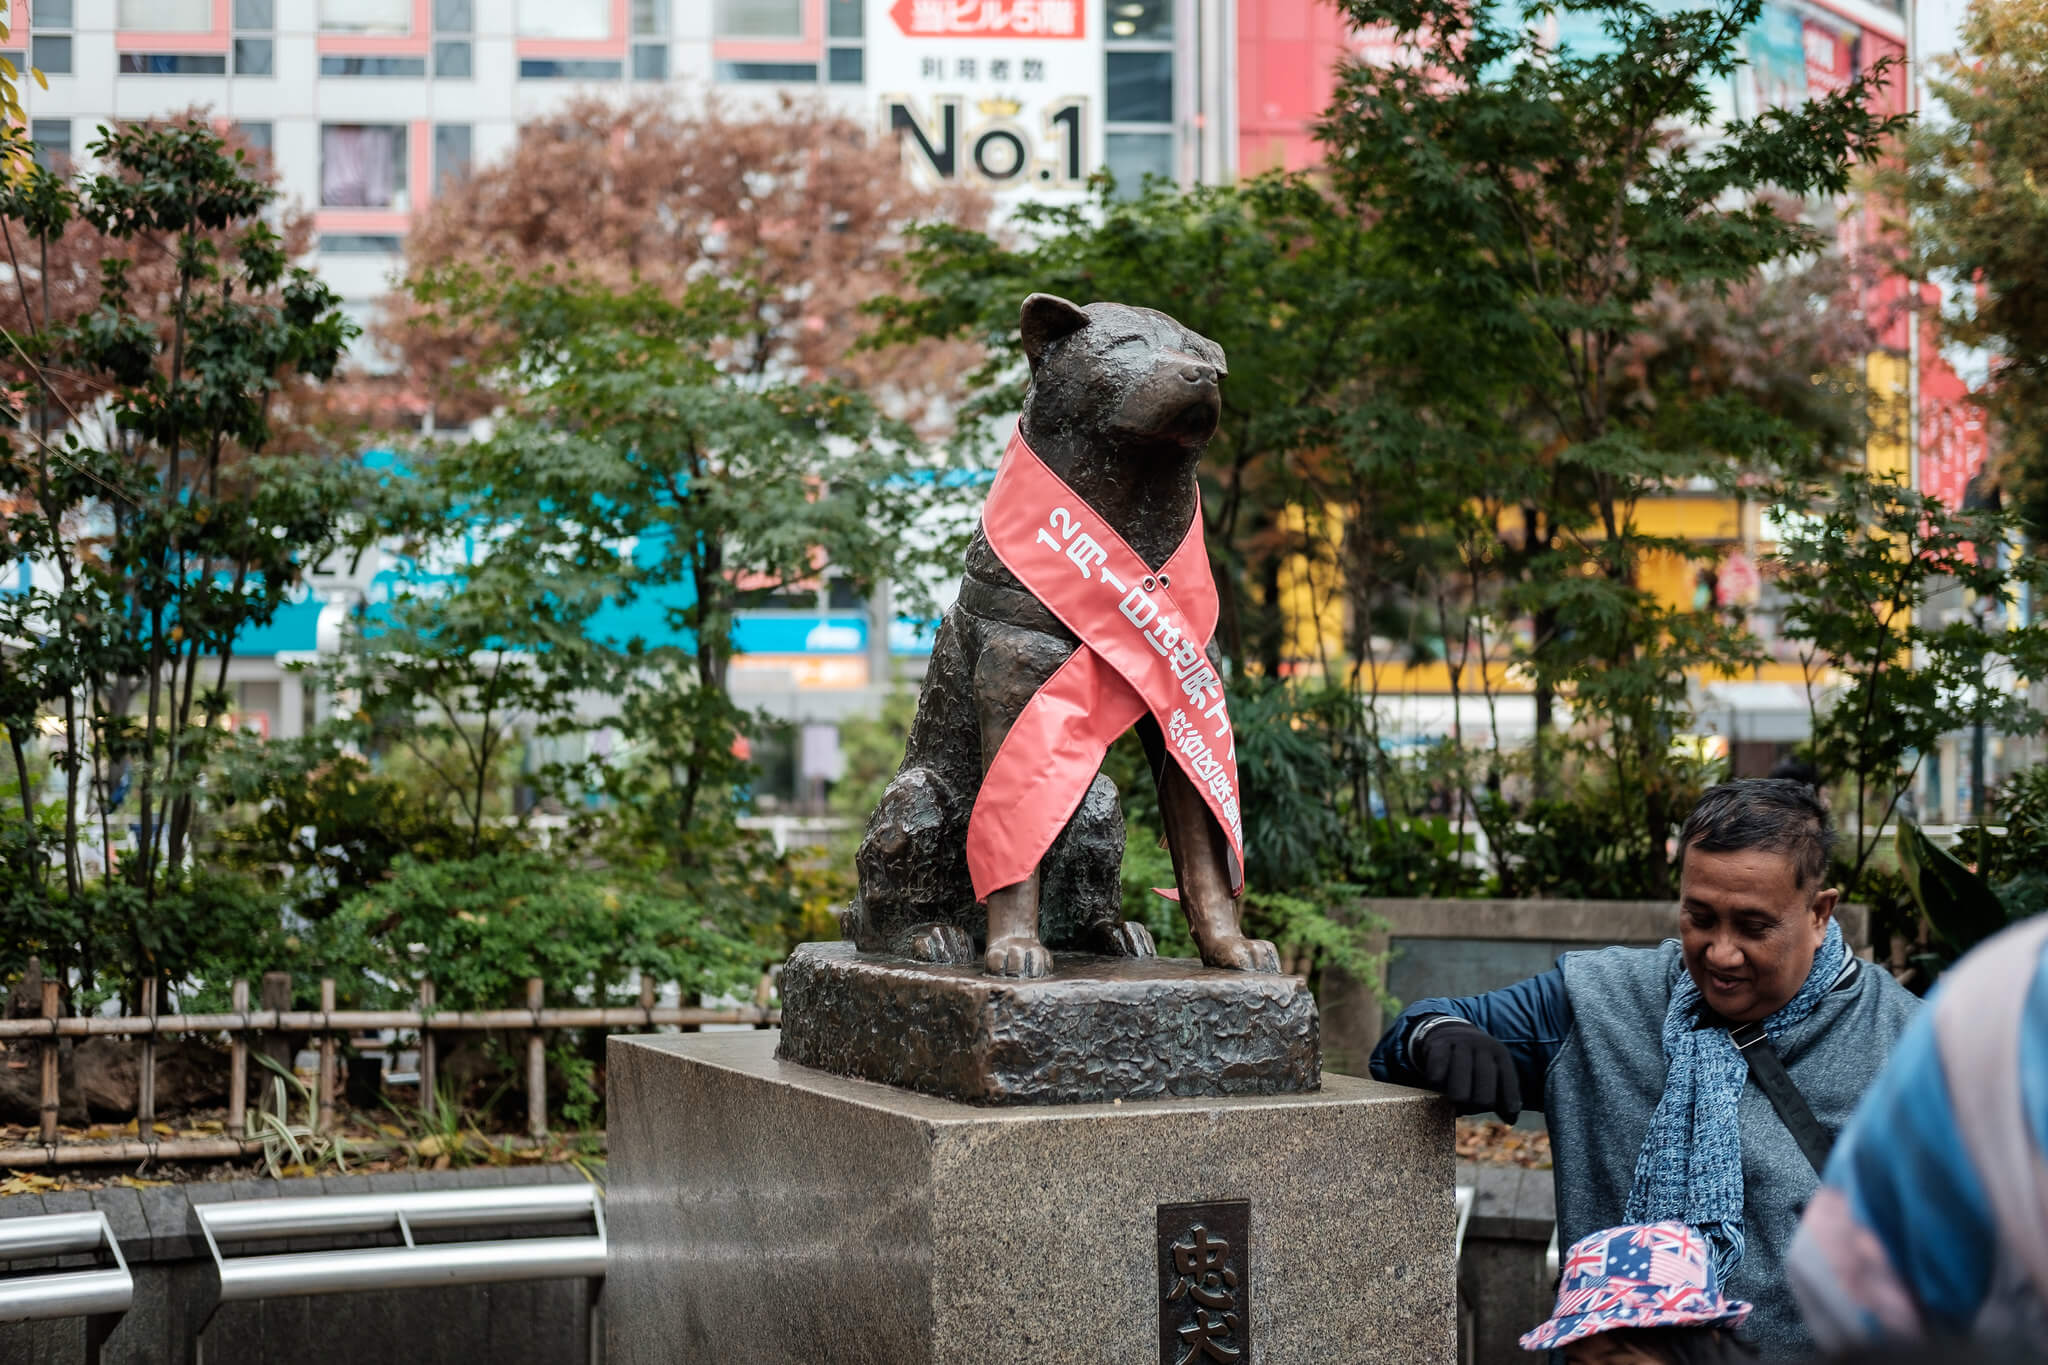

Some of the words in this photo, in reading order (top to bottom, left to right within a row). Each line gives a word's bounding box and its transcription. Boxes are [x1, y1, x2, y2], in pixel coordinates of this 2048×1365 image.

[921, 57, 1045, 81] 利用者数
[890, 102, 1080, 181] No.1
[1167, 1223, 1241, 1365] 忠犬
